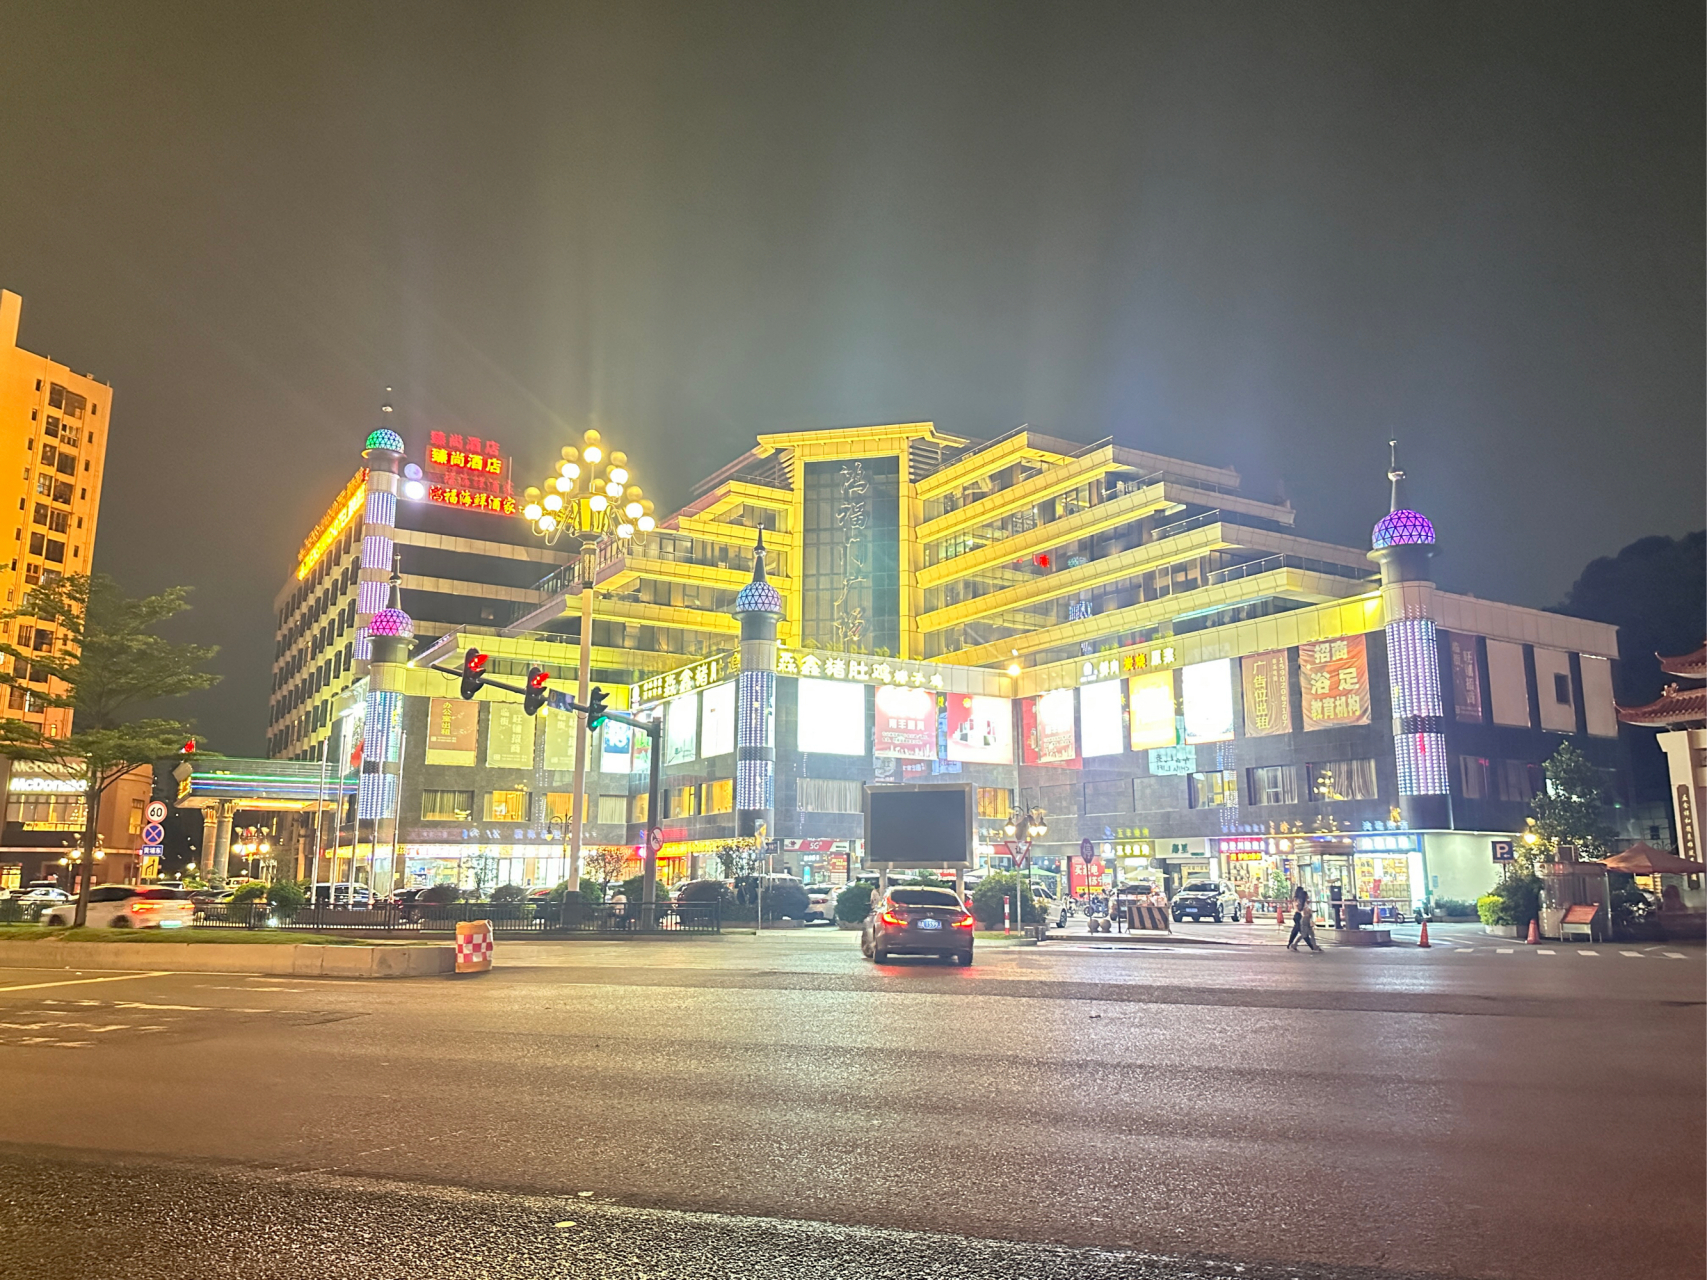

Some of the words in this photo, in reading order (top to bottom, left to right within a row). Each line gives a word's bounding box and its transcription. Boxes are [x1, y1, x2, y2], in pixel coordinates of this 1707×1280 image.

[431, 447, 502, 474] 臻尚酒店
[429, 485, 516, 514] 鸿福海鲜酒家
[1314, 641, 1348, 664] 招商
[1310, 667, 1359, 695] 浴足
[1252, 660, 1270, 730] 广告位出租
[1310, 694, 1361, 720] 教育机构
[440, 701, 453, 736] 办公室出租
[510, 714, 523, 754] 旺铺招商
[149, 806, 163, 818] 60
[809, 841, 820, 850] 5G
[1014, 845, 1023, 855] 让
[1083, 842, 1092, 859] 停
[1495, 843, 1508, 857] P
